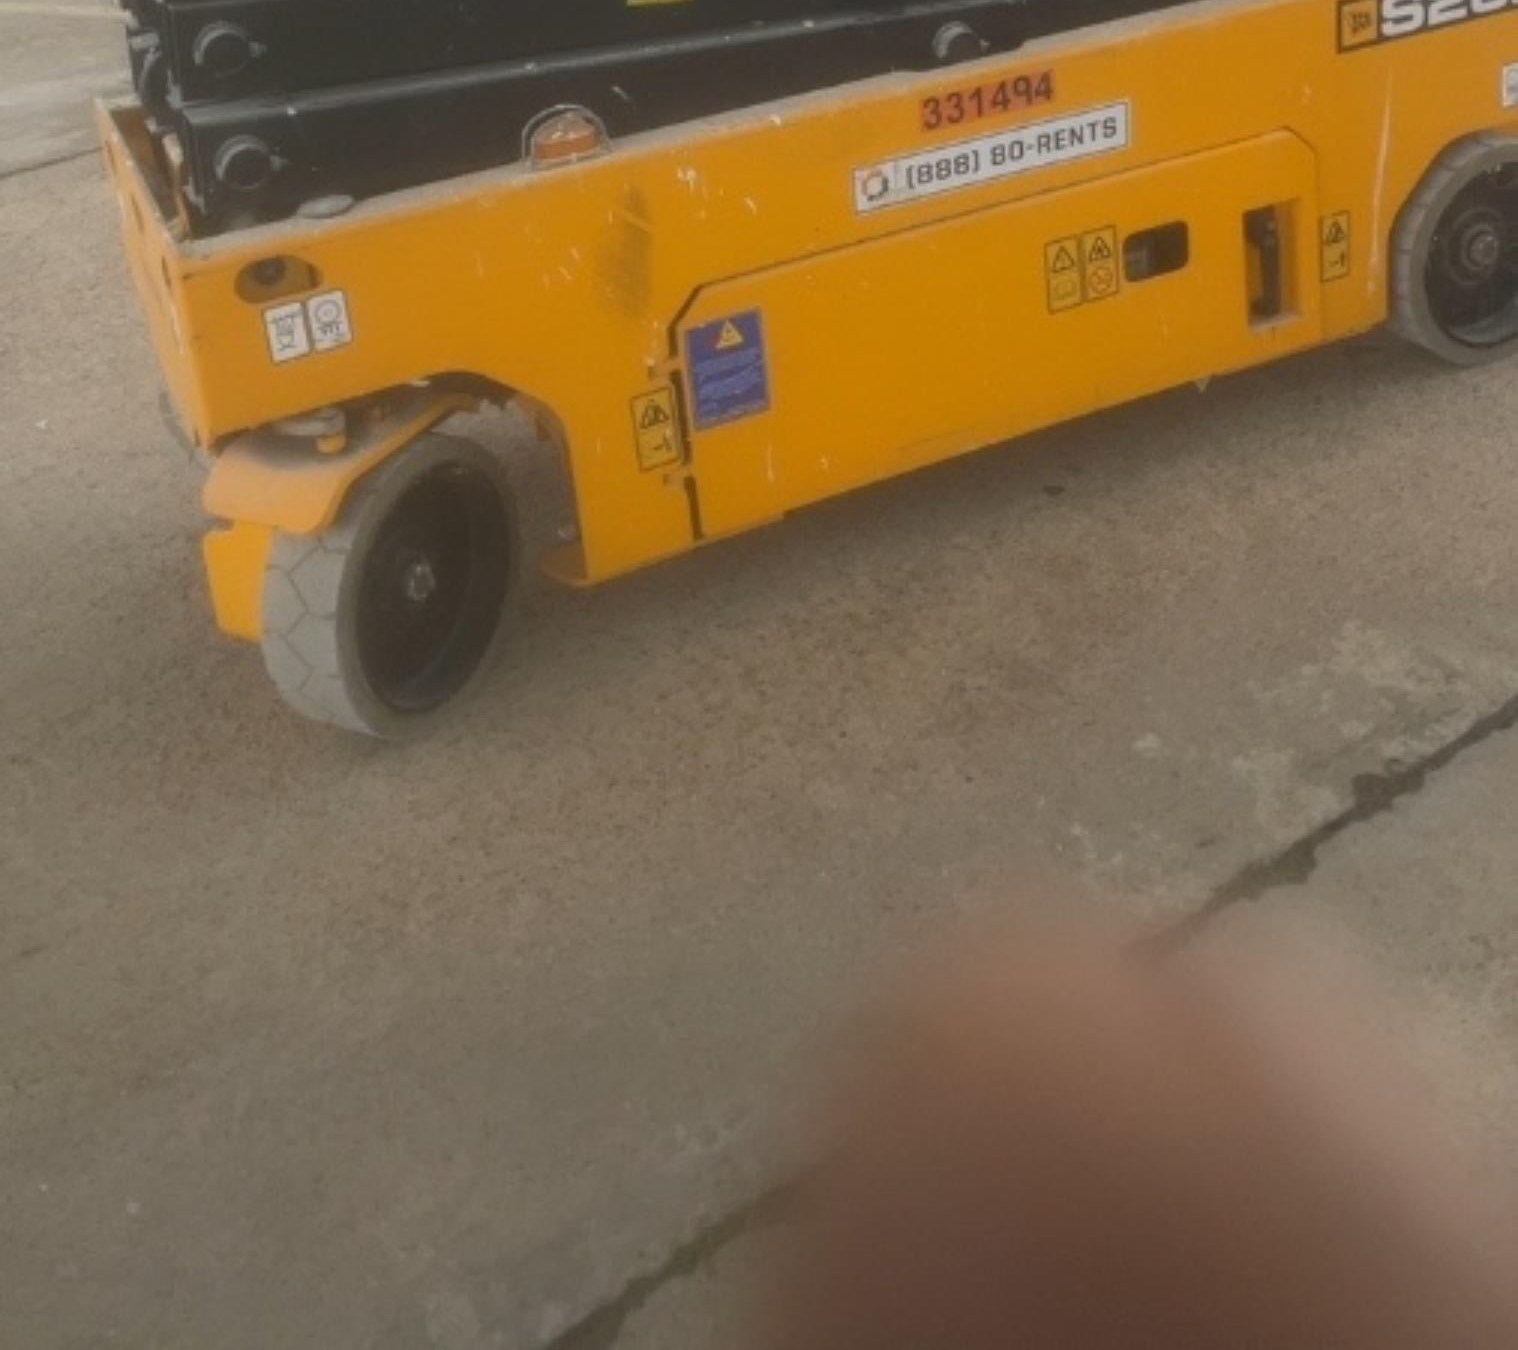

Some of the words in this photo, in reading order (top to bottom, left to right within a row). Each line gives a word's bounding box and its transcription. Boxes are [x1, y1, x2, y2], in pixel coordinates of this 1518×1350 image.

[922, 72, 1055, 130] 331494
[905, 151, 980, 190] (888)
[990, 117, 1118, 167] 80-RENTS
